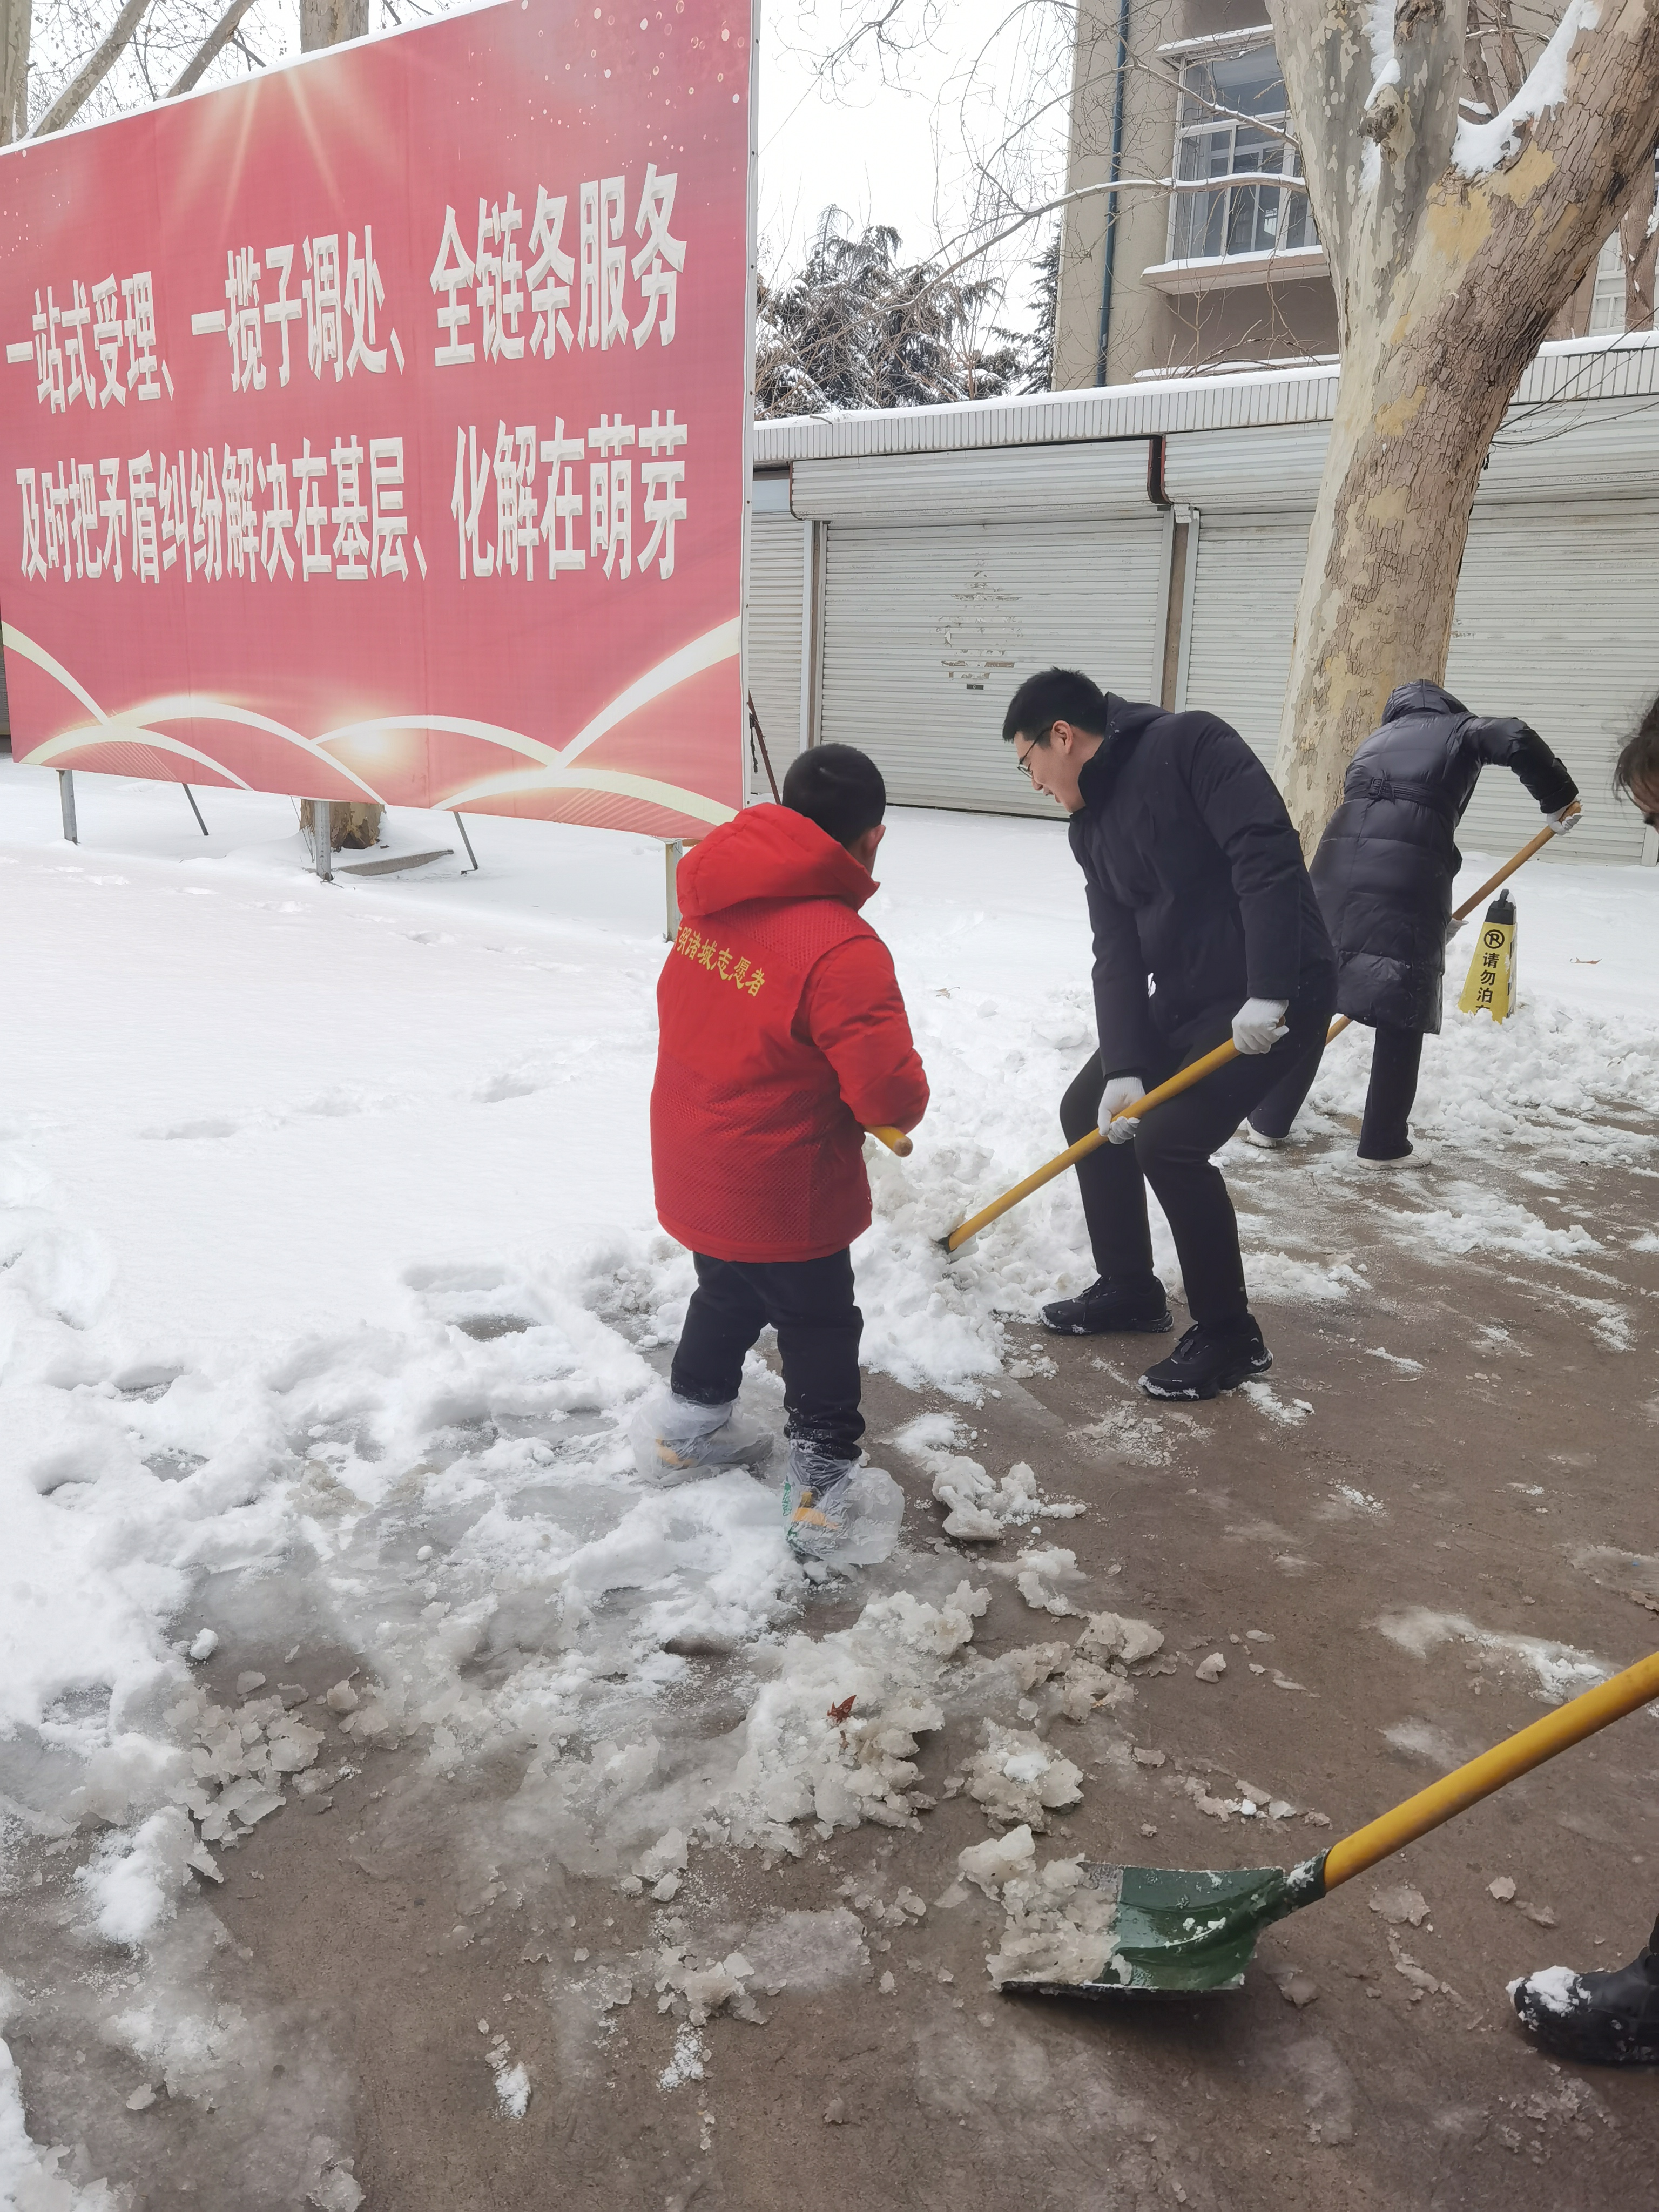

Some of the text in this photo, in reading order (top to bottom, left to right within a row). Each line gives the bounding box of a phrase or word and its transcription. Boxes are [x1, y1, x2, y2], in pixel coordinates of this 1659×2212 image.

[6, 161, 687, 414] 一站式受理、一揽子调处、全链条服务
[16, 409, 687, 584] 及时把矛盾纠纷解决在基层、化解在萌芽
